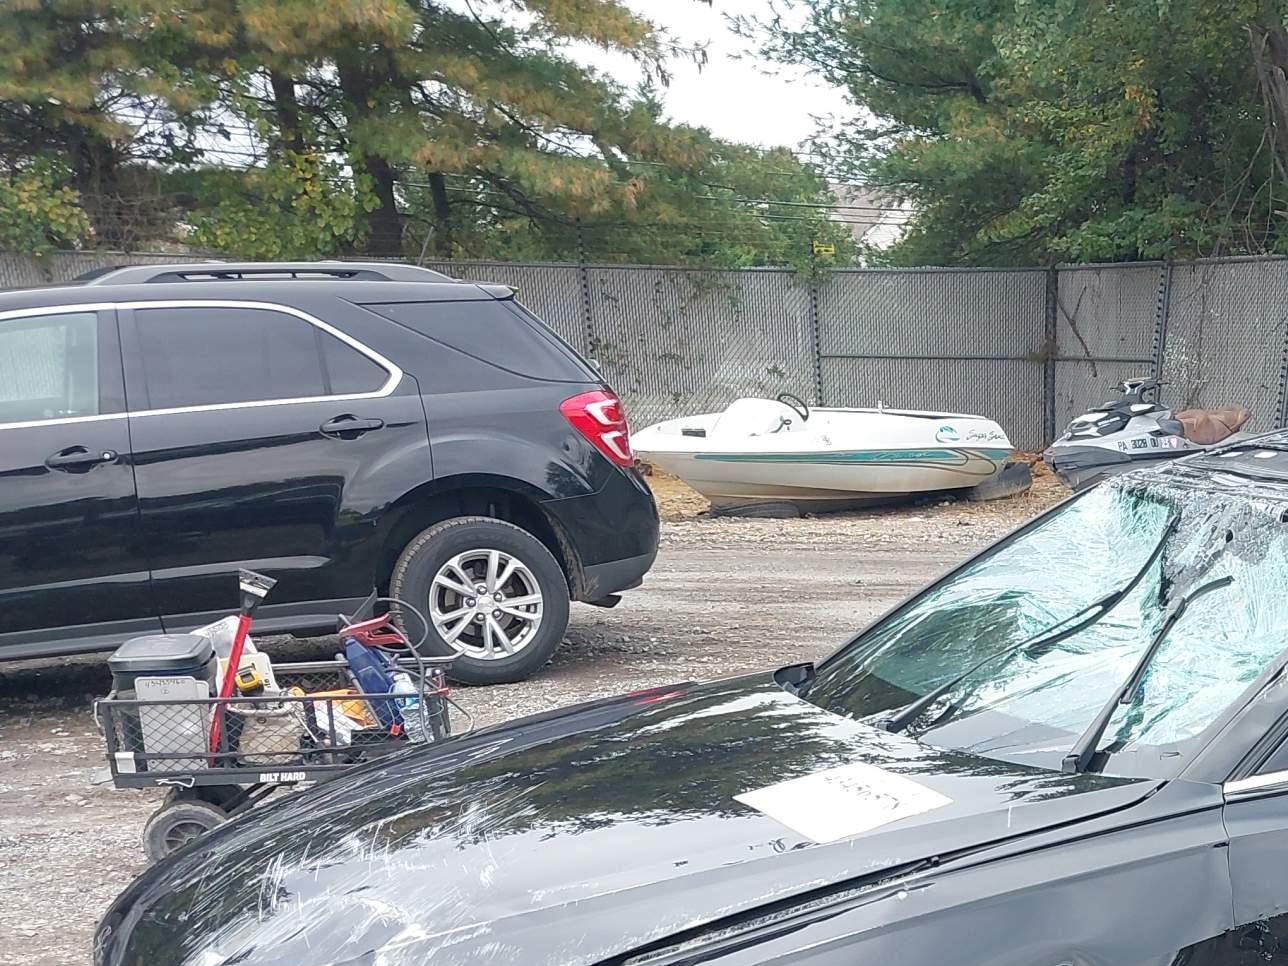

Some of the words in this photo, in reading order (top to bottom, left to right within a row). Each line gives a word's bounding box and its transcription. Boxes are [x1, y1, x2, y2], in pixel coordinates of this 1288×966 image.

[1117, 441, 1128, 451] PA
[259, 773, 279, 783] BILT
[280, 771, 306, 782] HARD
